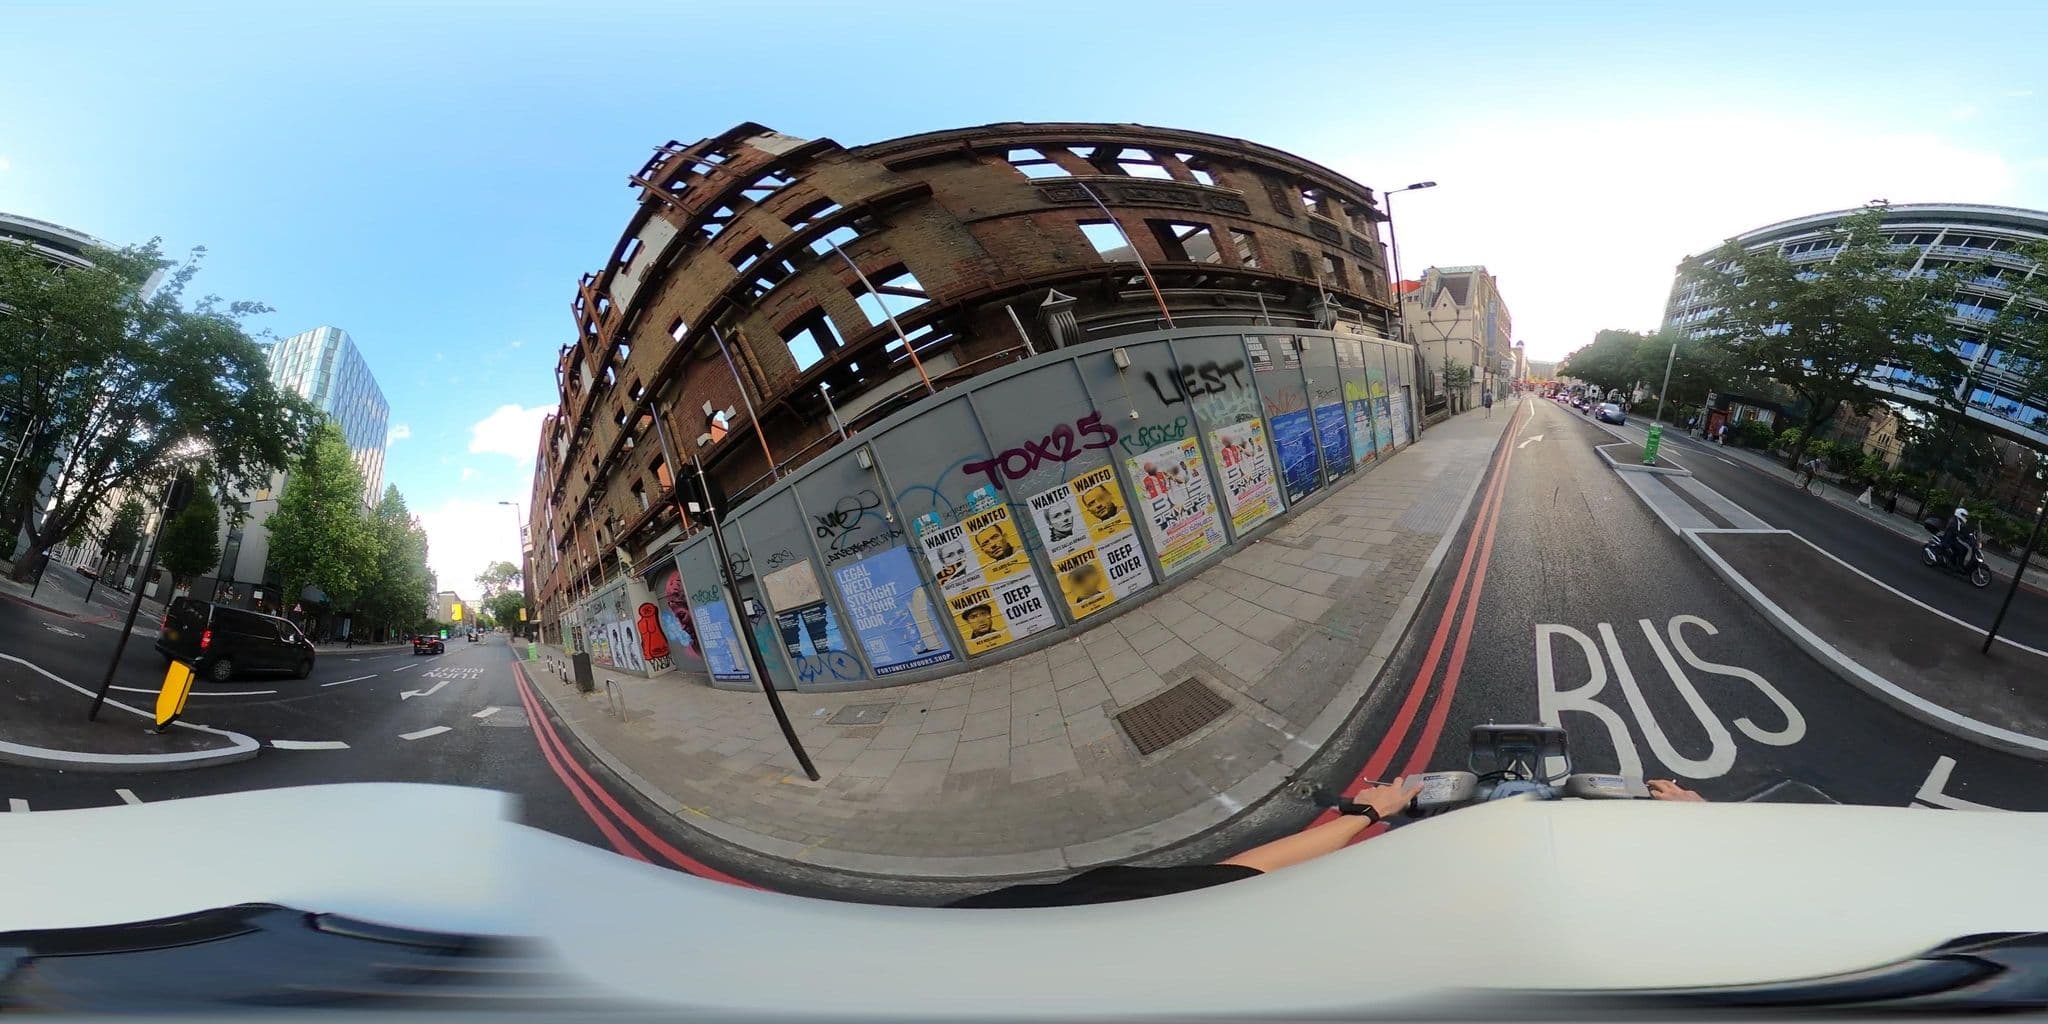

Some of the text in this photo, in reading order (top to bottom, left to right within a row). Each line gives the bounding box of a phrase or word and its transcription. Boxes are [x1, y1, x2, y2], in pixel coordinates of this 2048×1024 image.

[962, 410, 1119, 490] TOX25
[1074, 468, 1112, 493] WANTED
[1031, 485, 1070, 511] WANTED
[967, 507, 1007, 533] WANTED
[925, 525, 963, 549] WANTED
[1058, 549, 1096, 574] WANTED
[1107, 543, 1133, 565] DEEP
[837, 564, 871, 584] LEGAL
[1109, 555, 1142, 580] COVER
[842, 577, 872, 597] WEED
[847, 582, 897, 610] STRAIGHT
[1002, 584, 1031, 605] DEEP
[852, 597, 898, 620] TO YOUR
[951, 588, 990, 611] WANTED
[1006, 597, 1043, 620] COVER
[857, 612, 886, 631] DOOR
[1535, 614, 1807, 786] BUS
